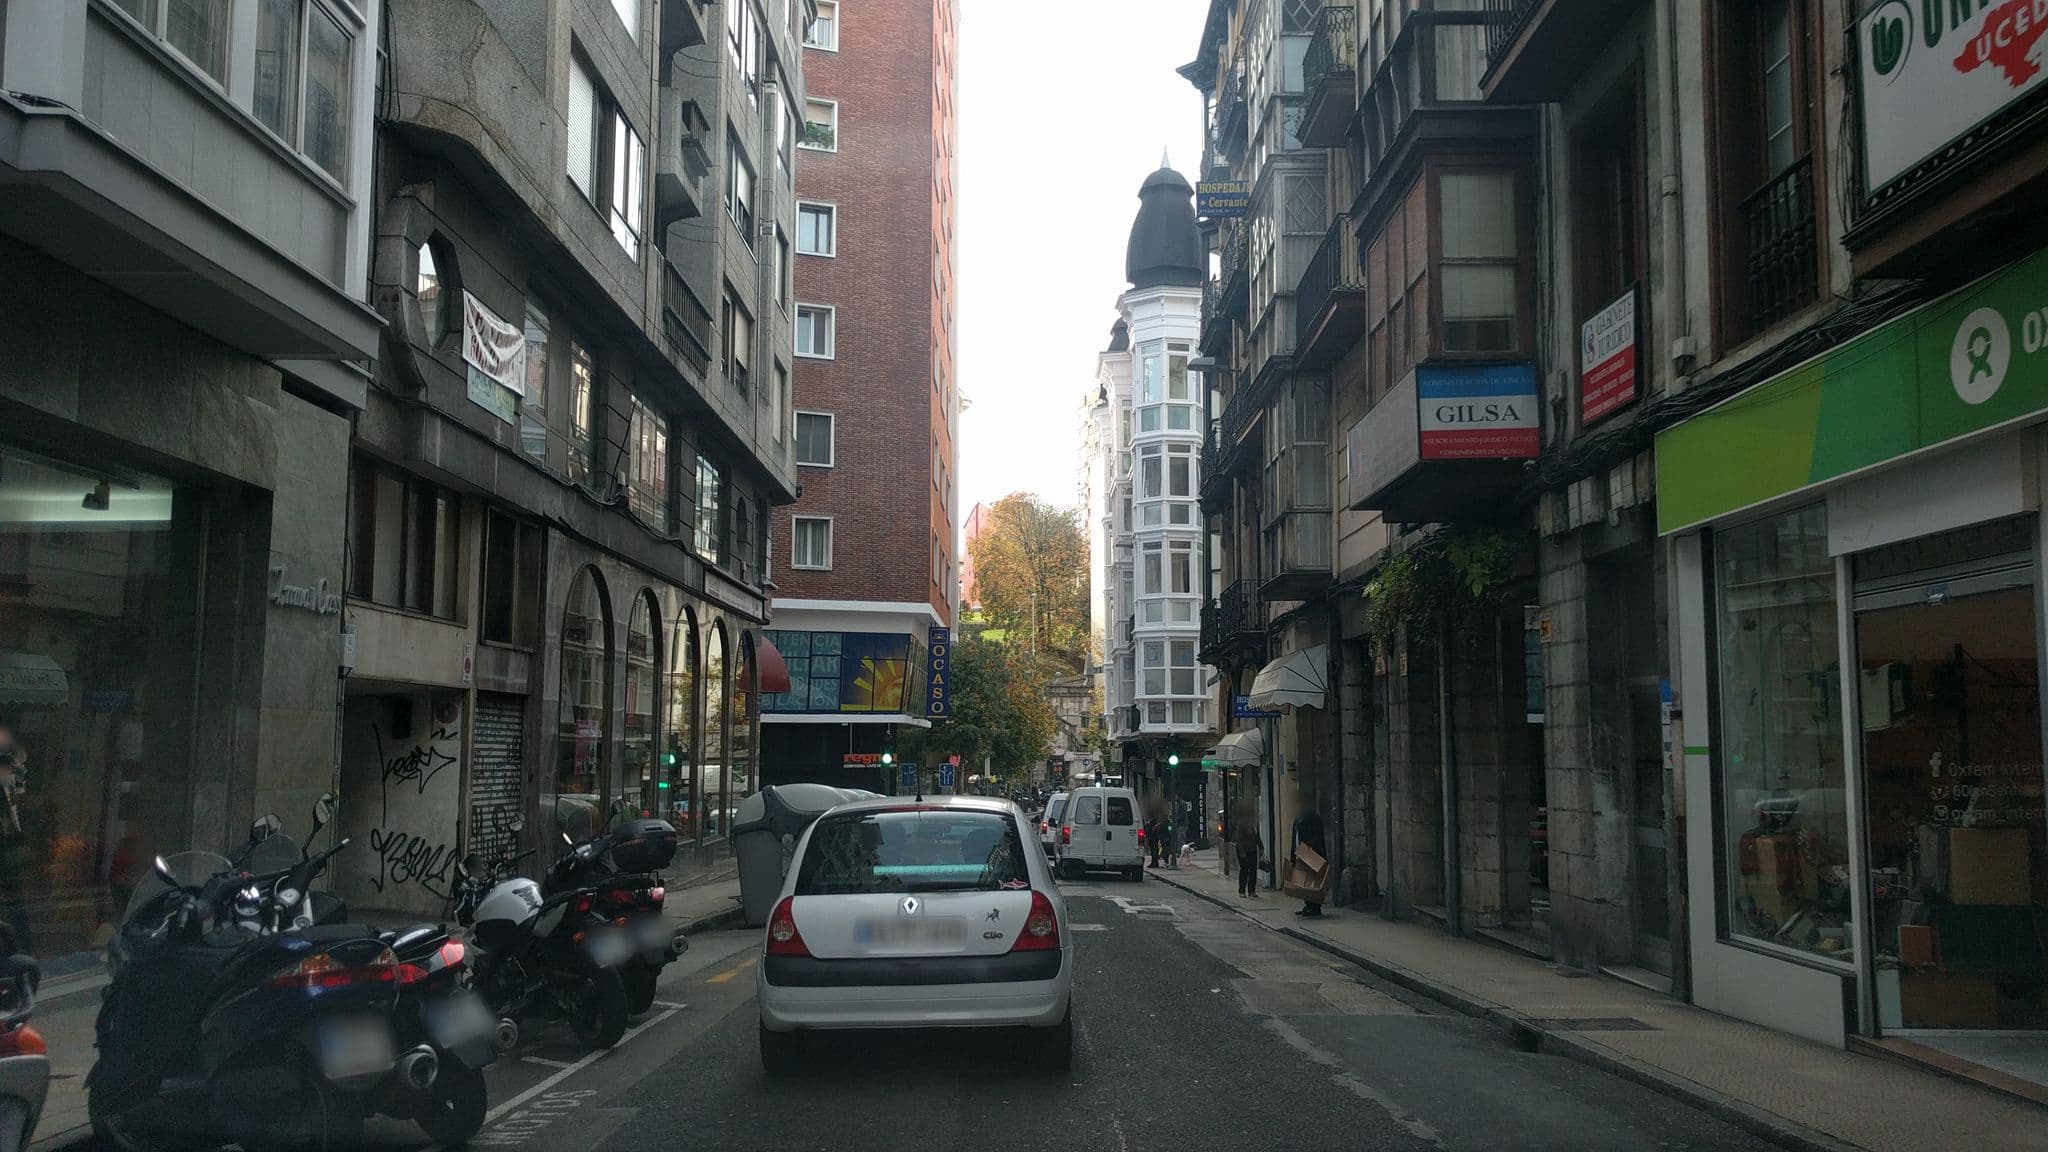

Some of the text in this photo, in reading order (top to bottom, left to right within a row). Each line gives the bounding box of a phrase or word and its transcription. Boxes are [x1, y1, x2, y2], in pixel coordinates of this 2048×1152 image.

[1596, 295, 1633, 336] GABINETE
[1436, 403, 1521, 424] GILSA
[931, 644, 947, 714] OCASO
[983, 931, 1003, 939] Clio
